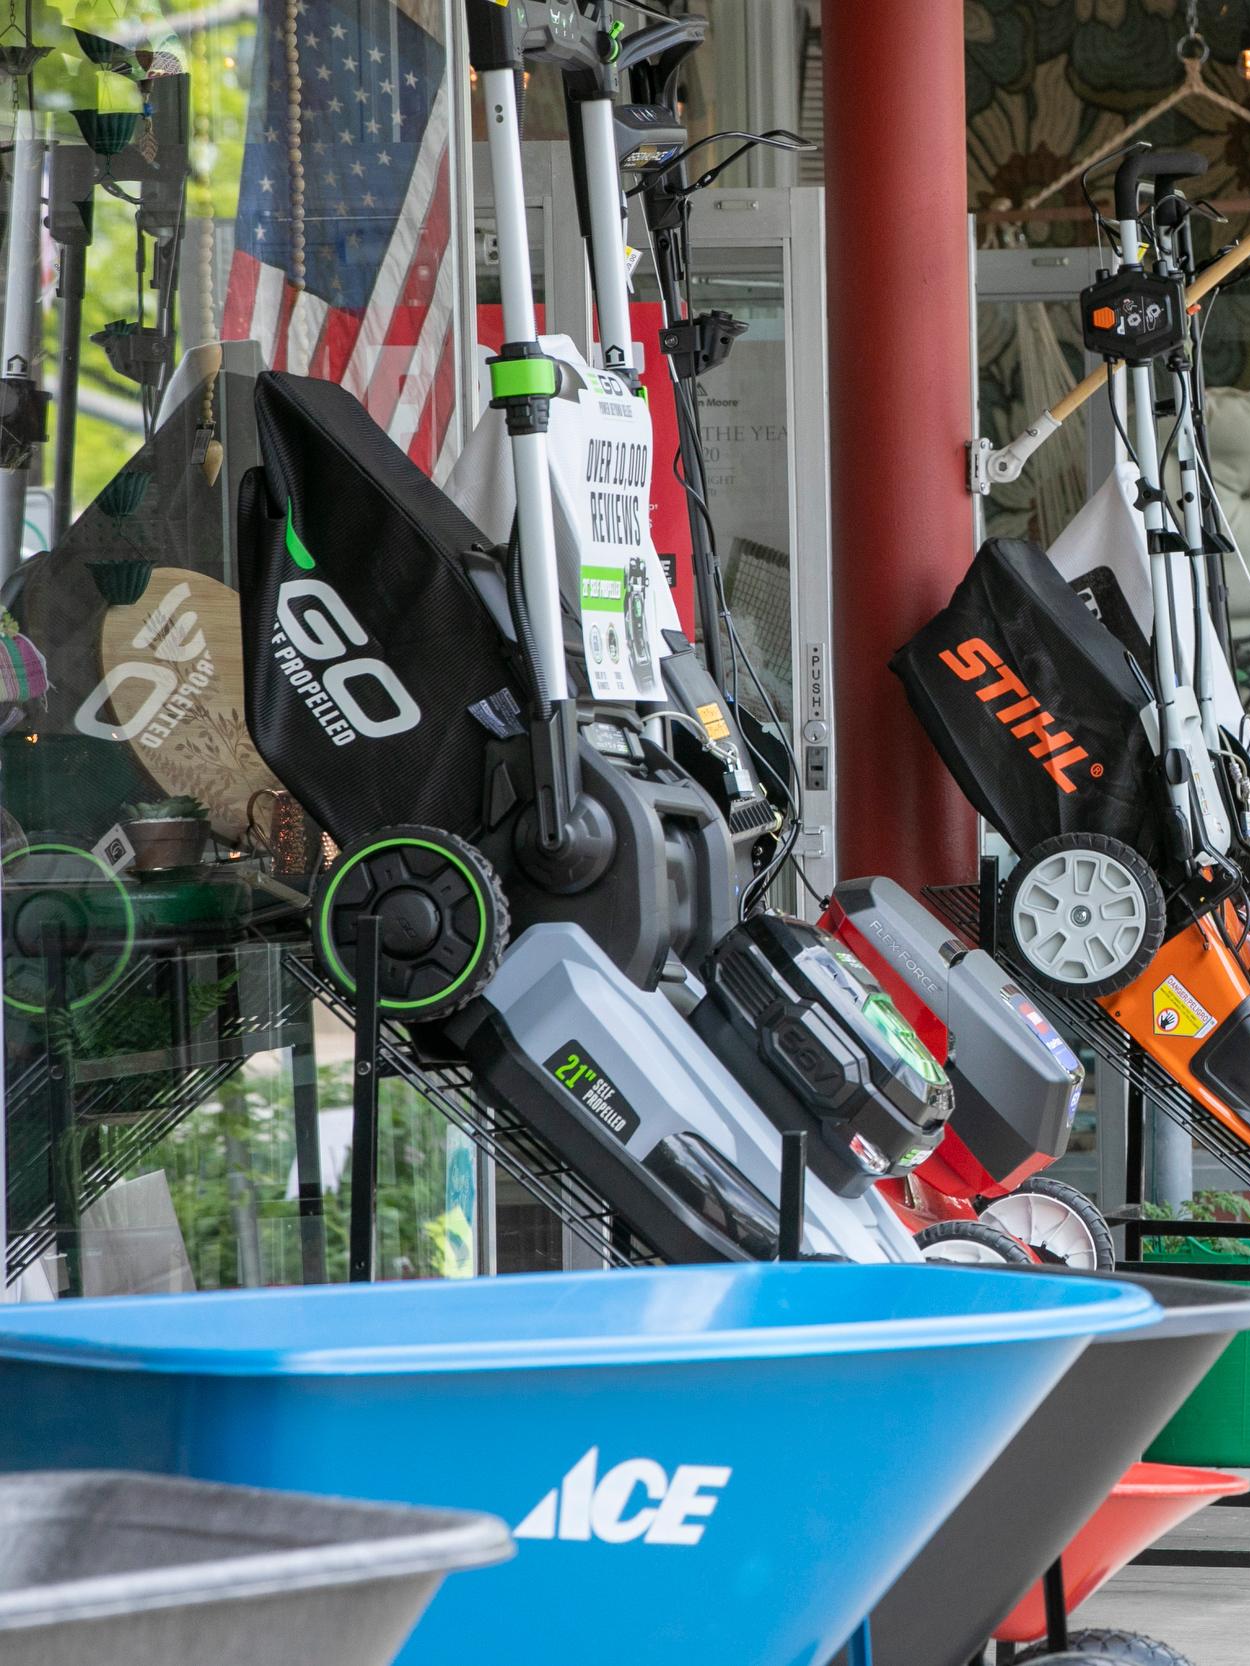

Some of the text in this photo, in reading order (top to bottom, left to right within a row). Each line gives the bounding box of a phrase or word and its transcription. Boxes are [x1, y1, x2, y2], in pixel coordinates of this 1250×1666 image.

[706, 398, 738, 407] Moore
[702, 426, 787, 441] THE YEA
[586, 438, 647, 491] OVER 10,000
[590, 491, 641, 546] REVIEWS
[274, 646, 356, 746] PROPELLED
[811, 655, 821, 707] PUSH
[582, 1089, 627, 1132] PROPELLED
[592, 1078, 616, 1101] SELF
[511, 1445, 733, 1545] ACE
